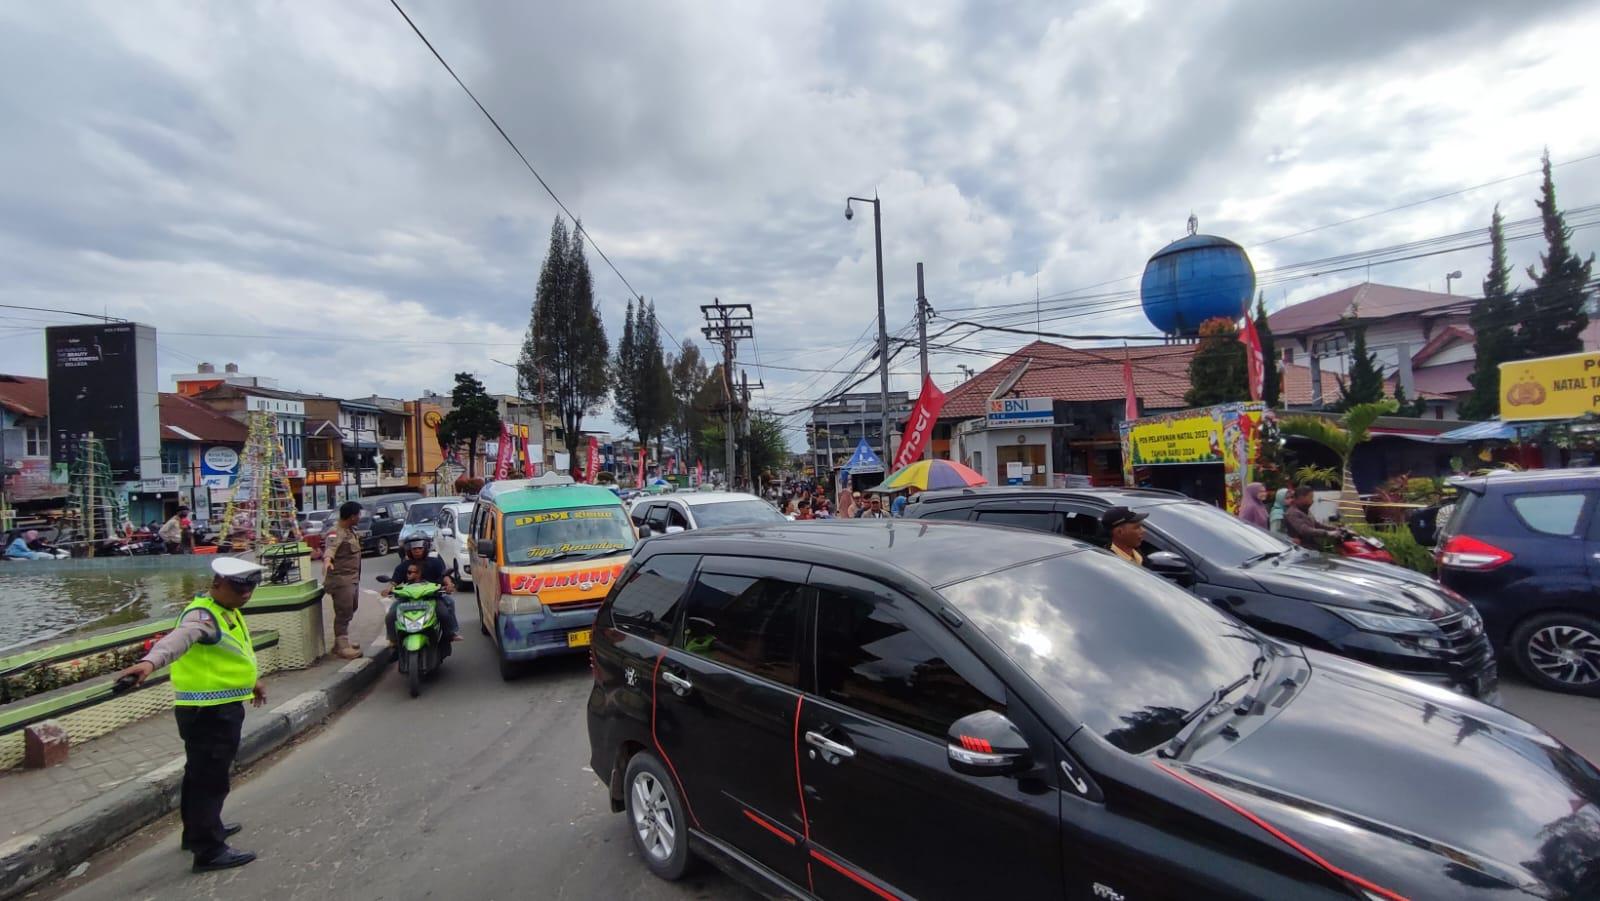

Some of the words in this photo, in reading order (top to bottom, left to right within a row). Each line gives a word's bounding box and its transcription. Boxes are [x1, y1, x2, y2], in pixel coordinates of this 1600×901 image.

[1553, 377, 1588, 392] NATAL
[1005, 399, 1029, 411] BNI
[1149, 433, 1176, 443] PELAYANAN
[1177, 431, 1194, 440] NATAL
[1194, 429, 1208, 439] 2023
[1152, 449, 1167, 457] TAHUN
[1168, 448, 1181, 456] BARU
[1182, 447, 1195, 456] 2024
[515, 511, 571, 527] DEM
